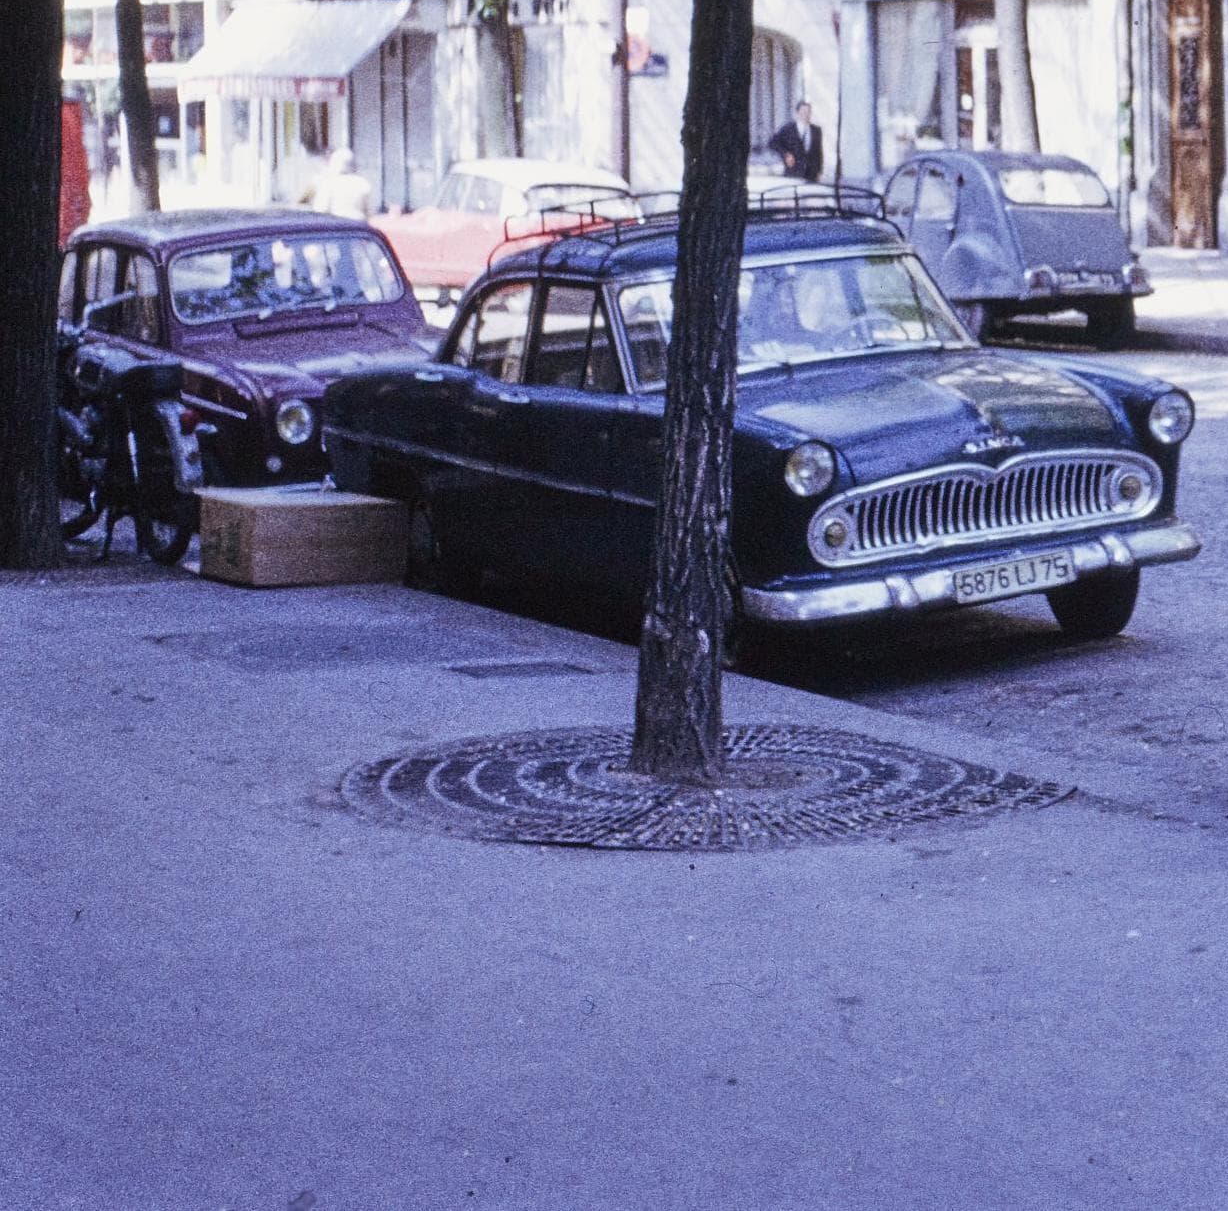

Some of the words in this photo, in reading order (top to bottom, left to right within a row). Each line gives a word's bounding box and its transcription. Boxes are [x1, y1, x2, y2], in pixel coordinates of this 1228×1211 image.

[959, 566, 1010, 597] 5876
[1014, 560, 1037, 586] LJ
[1040, 555, 1069, 581] 75
